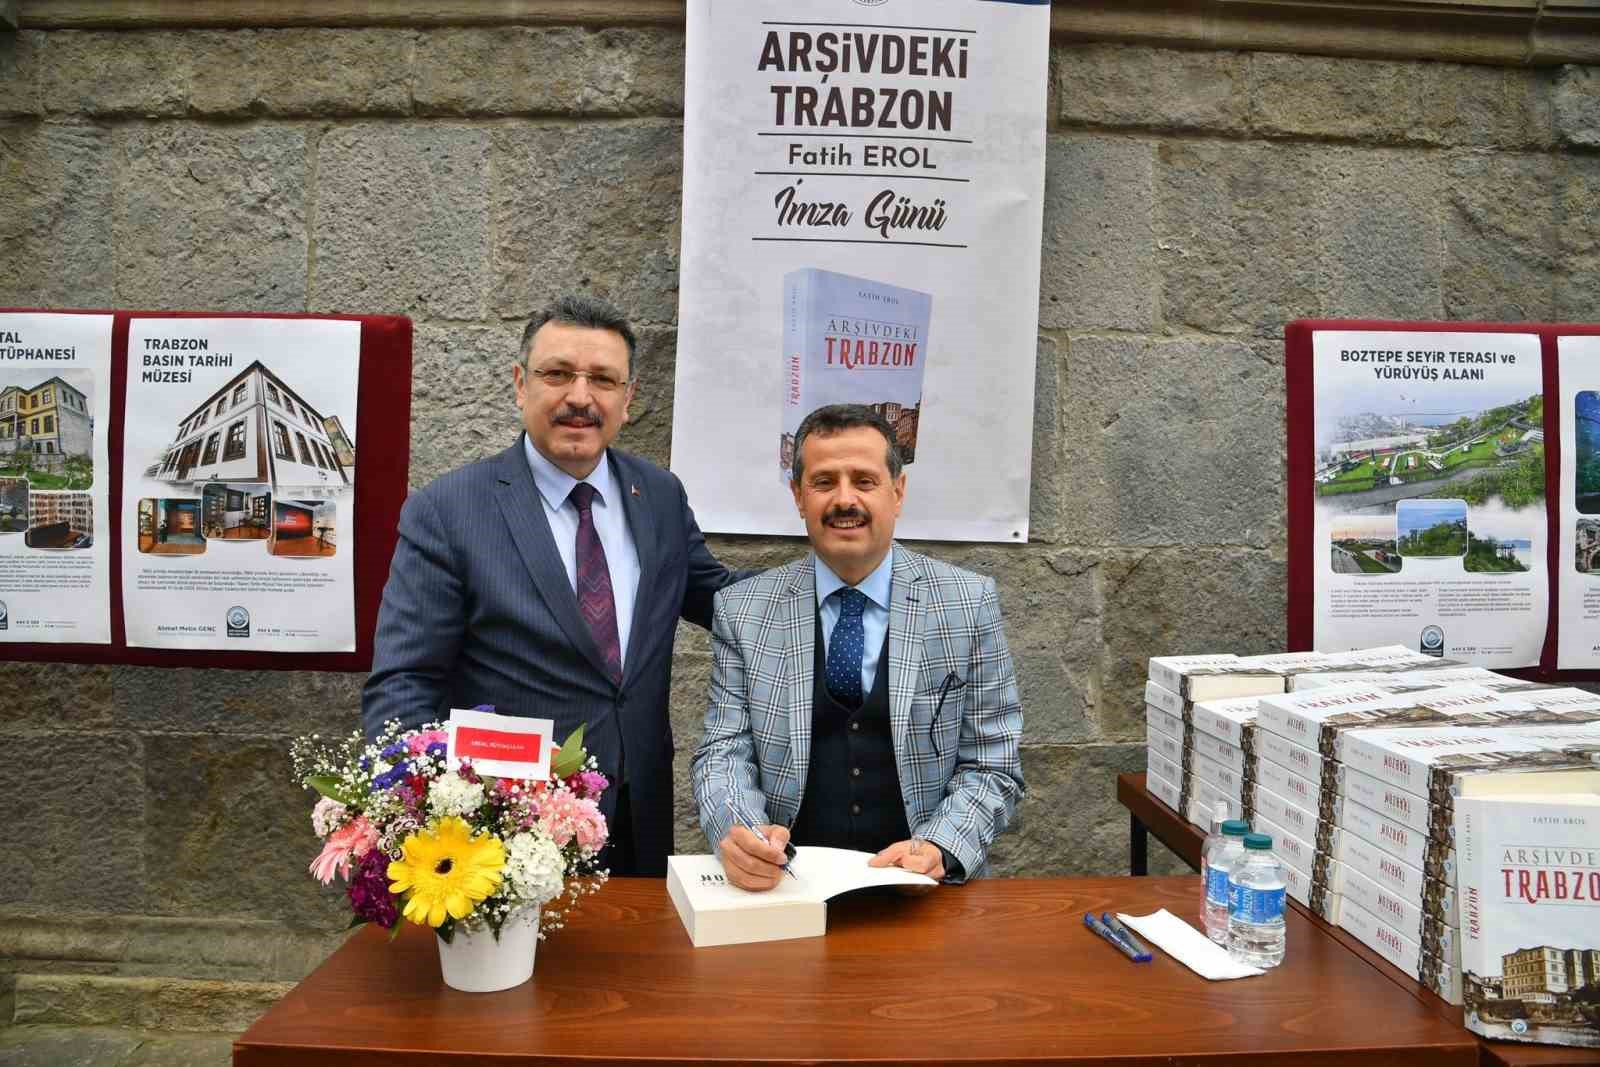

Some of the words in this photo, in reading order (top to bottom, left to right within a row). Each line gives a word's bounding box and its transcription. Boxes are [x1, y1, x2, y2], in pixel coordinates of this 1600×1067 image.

[770, 85, 953, 131] TRABZON
[788, 143, 852, 166] Fatih
[863, 144, 937, 169] EROL
[775, 178, 853, 226] İmza
[864, 189, 947, 239] Günü
[143, 338, 208, 350] TRABZON
[143, 355, 184, 367] BASIN
[188, 353, 233, 367] TARİHİ
[824, 337, 918, 370] TRABZON
[1340, 350, 1403, 362] BOZTEPE
[1449, 351, 1497, 364] TERASI
[1500, 353, 1516, 364] ve
[142, 369, 192, 383] MÜZESİ
[1374, 365, 1439, 381] YÜRÜYÜŞ
[1442, 368, 1484, 380] ALANI
